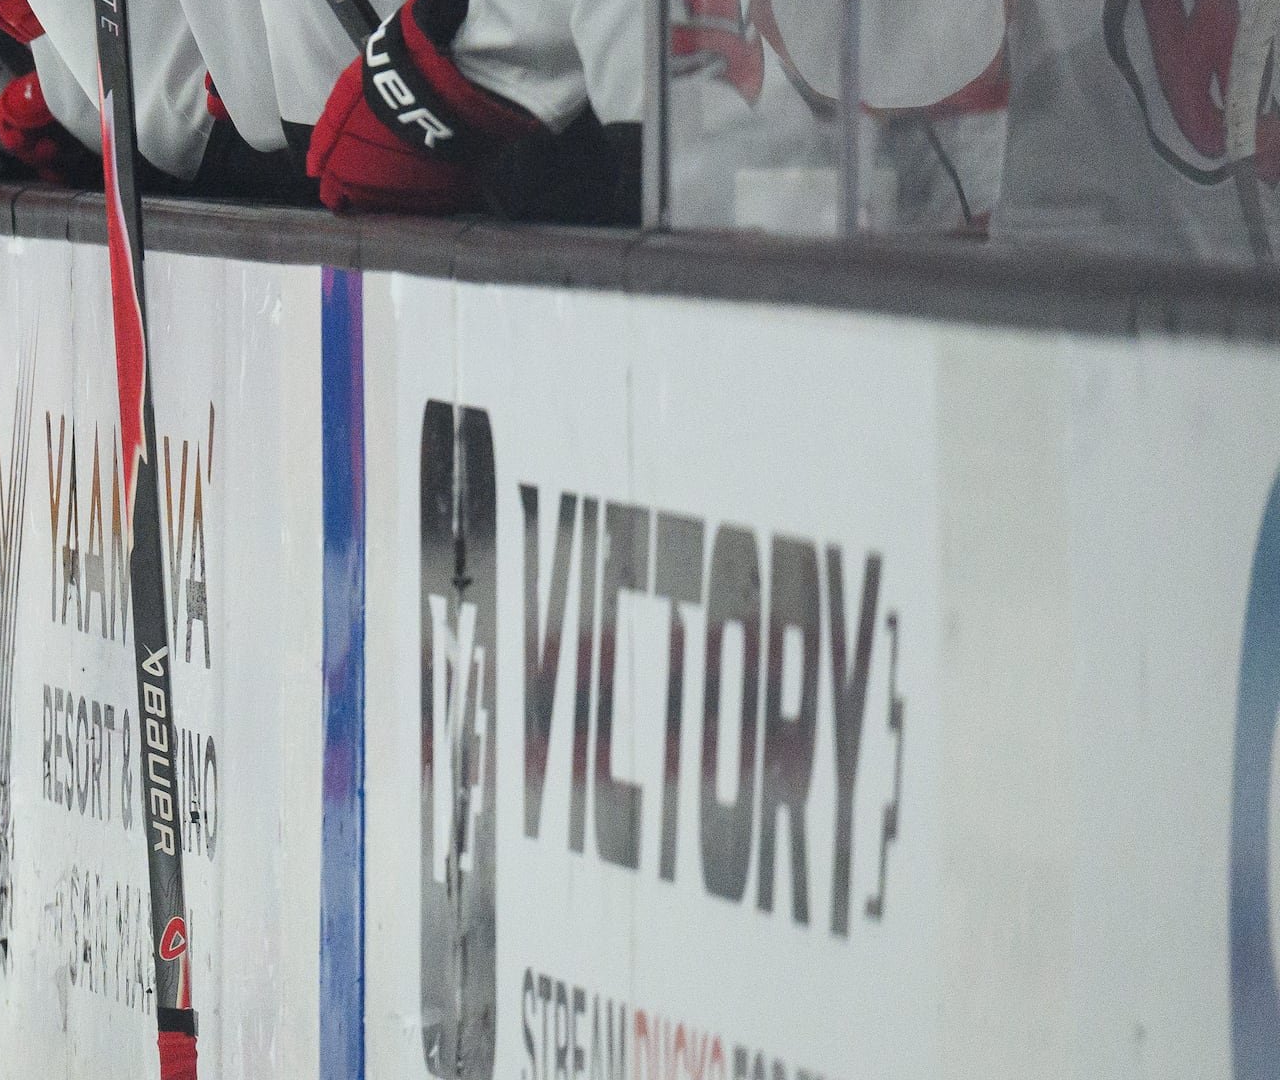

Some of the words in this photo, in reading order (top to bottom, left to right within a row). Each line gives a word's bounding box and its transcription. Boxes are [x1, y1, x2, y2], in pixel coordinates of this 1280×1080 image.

[42, 683, 115, 822] RESORT
[121, 707, 134, 831] &
[143, 682, 176, 857] BAUER
